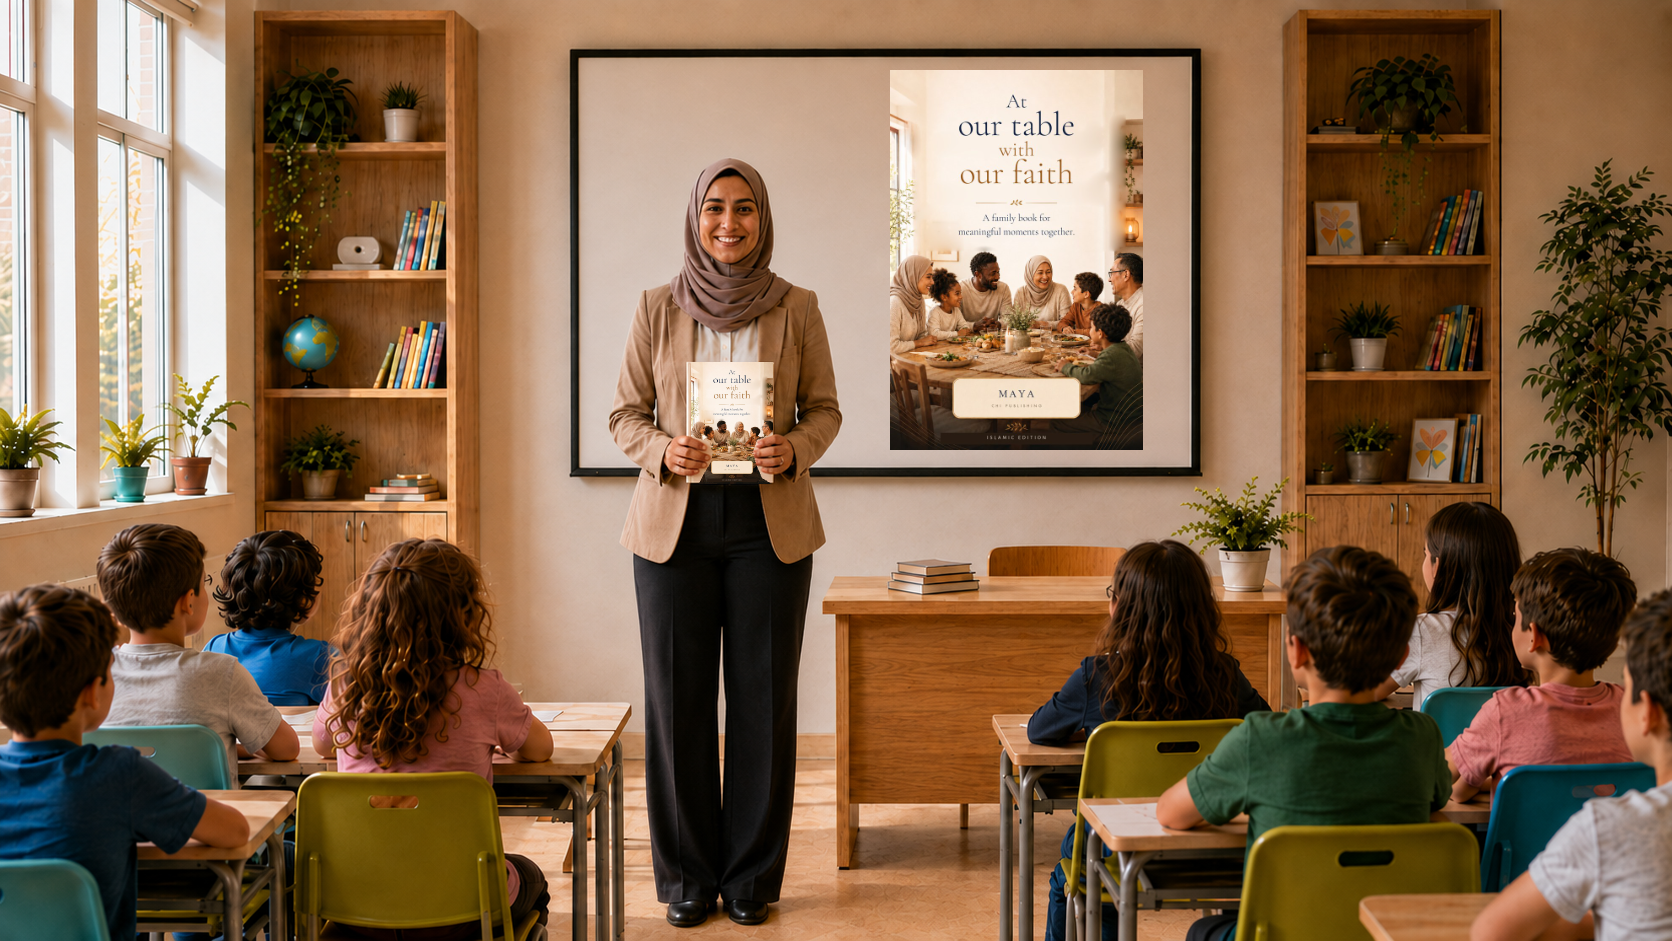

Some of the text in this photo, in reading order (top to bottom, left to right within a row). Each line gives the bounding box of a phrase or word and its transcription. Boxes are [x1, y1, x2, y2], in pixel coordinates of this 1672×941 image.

[1006, 94, 1027, 108] At
[958, 110, 1074, 136] our table
[999, 141, 1034, 156] with
[960, 158, 1073, 184] our faith
[982, 213, 1051, 224] A family book for
[958, 227, 1002, 238] meaningful
[1041, 227, 1075, 238] together.
[730, 374, 752, 384] table
[730, 390, 751, 399] faith
[998, 390, 1035, 398] MAYA
